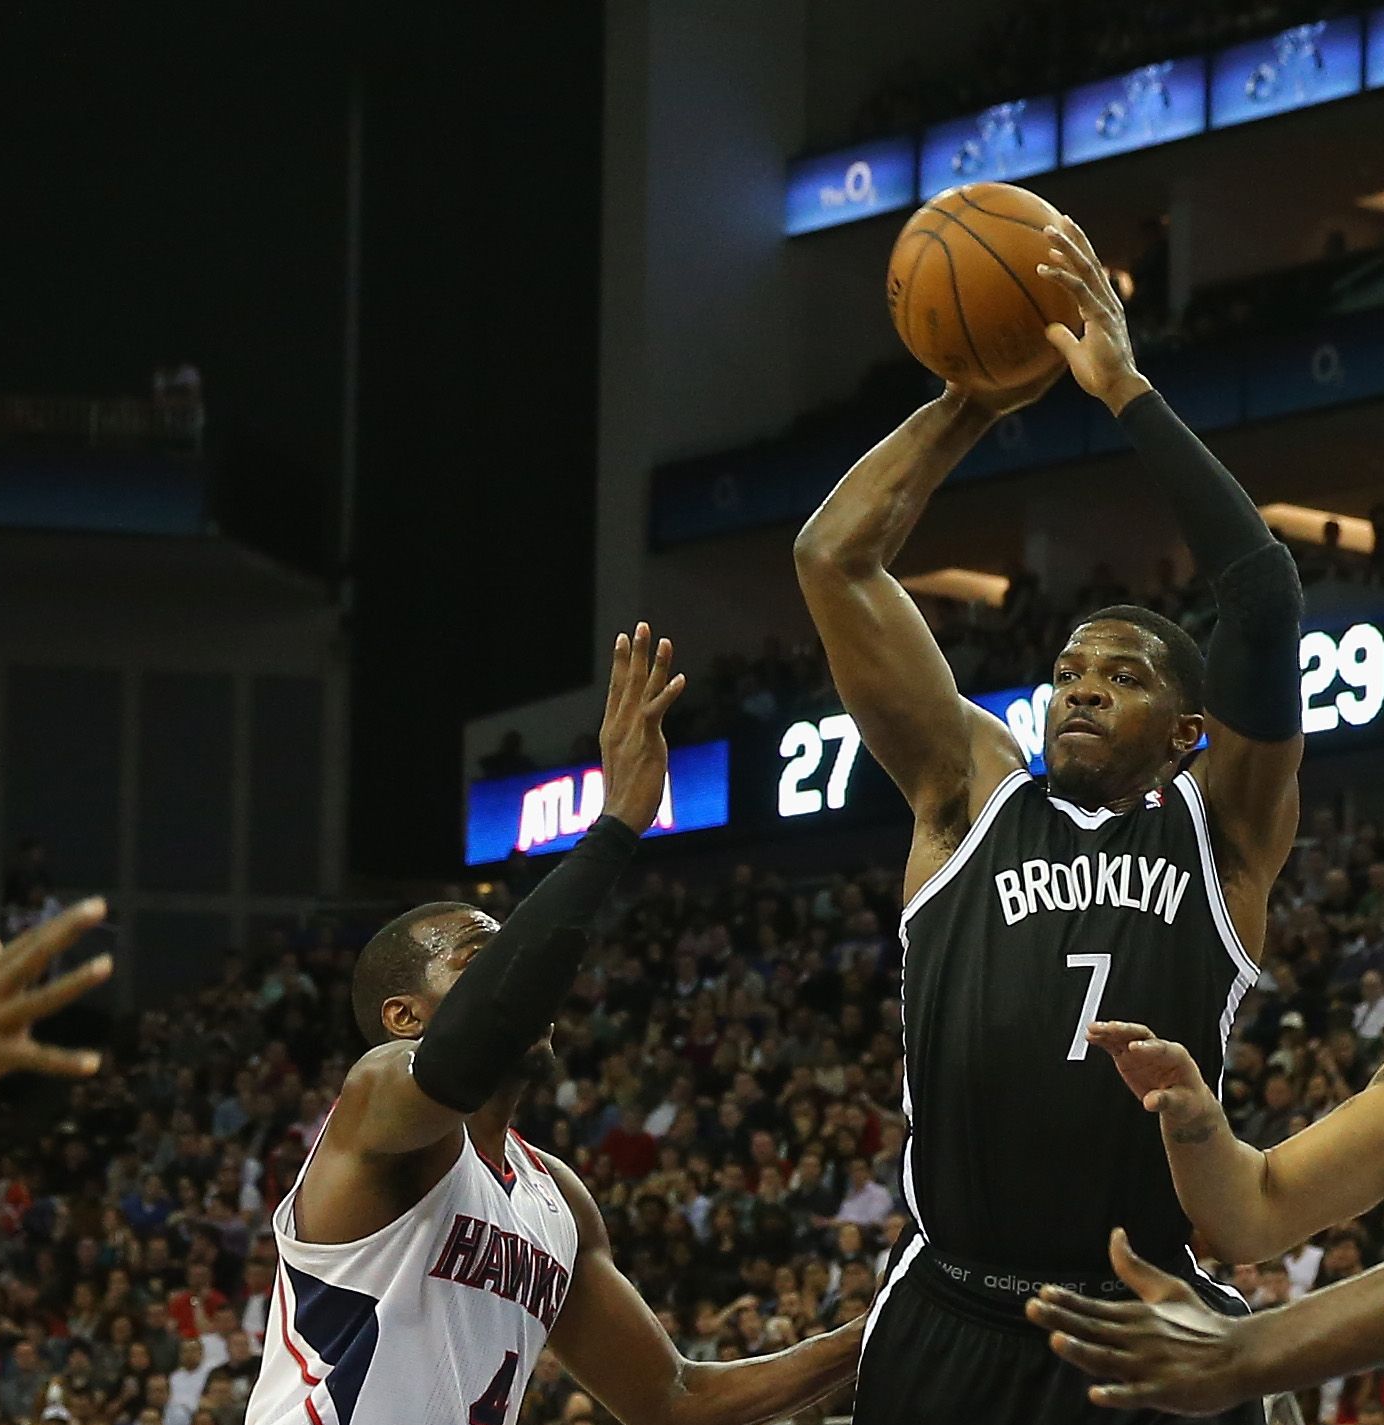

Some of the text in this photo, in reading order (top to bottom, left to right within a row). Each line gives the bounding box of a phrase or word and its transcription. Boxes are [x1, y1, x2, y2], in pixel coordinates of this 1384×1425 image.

[778, 713, 862, 817] 27
[994, 851, 1191, 927] BROOKLYN
[1066, 953, 1112, 1061] 7
